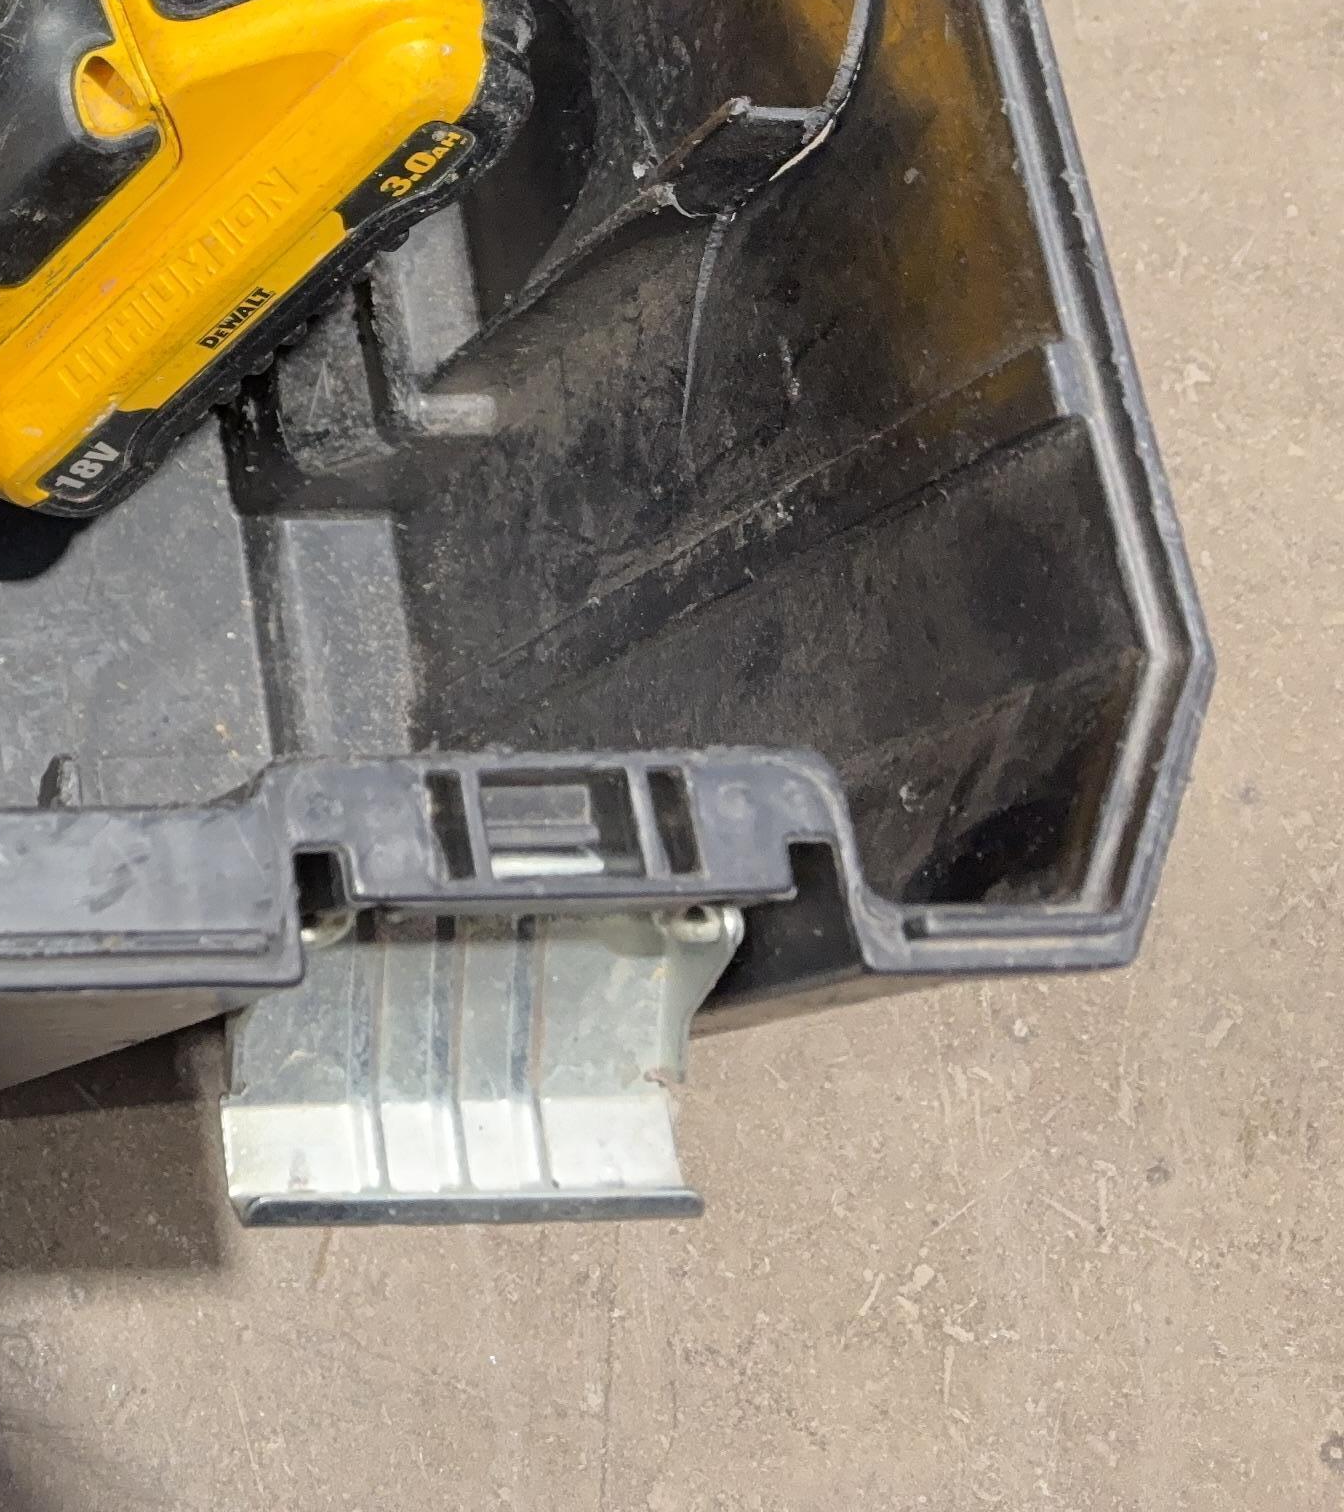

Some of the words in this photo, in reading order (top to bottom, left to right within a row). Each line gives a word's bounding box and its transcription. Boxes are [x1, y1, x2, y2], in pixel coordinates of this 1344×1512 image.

[53, 238, 225, 399] LITHIUM
[206, 164, 302, 256] ION
[198, 287, 272, 349] DEWALT
[54, 440, 121, 489] 18V
